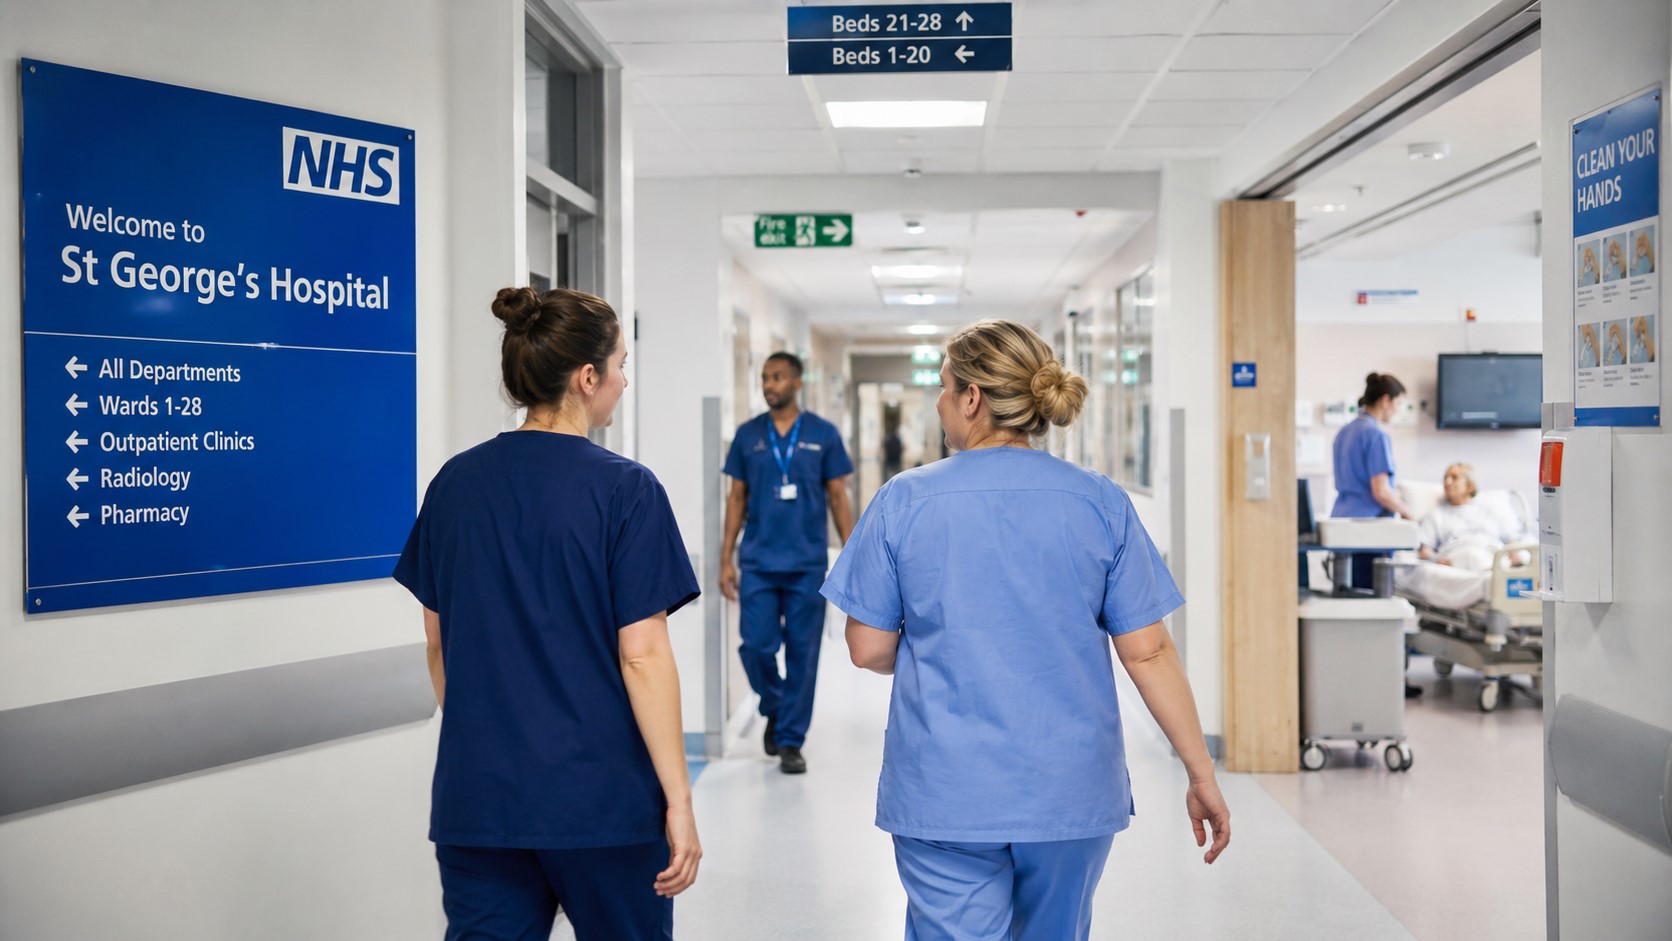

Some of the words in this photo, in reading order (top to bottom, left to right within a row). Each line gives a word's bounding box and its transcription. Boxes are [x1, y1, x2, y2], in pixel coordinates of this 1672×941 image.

[832, 14, 880, 33] Beds
[886, 13, 942, 32] 21-28
[832, 46, 881, 65] Beds
[887, 45, 931, 64] 1-20
[287, 134, 395, 197] NHS
[1577, 146, 1615, 180] CLEAN
[1617, 127, 1655, 163] YOUR
[1577, 175, 1622, 213] HANDS
[65, 203, 176, 241] Welcome
[181, 219, 206, 244] to
[61, 245, 100, 286] St
[110, 250, 260, 305] George’s
[270, 267, 390, 314] Hospital
[98, 357, 124, 380] All
[129, 359, 242, 385] Departments
[99, 394, 159, 417] Wards
[164, 396, 203, 417] 1-28
[99, 430, 199, 457] Outpatient
[203, 430, 255, 452] Clinics
[100, 466, 191, 492] Radiology
[100, 504, 190, 527] Pharmacy
